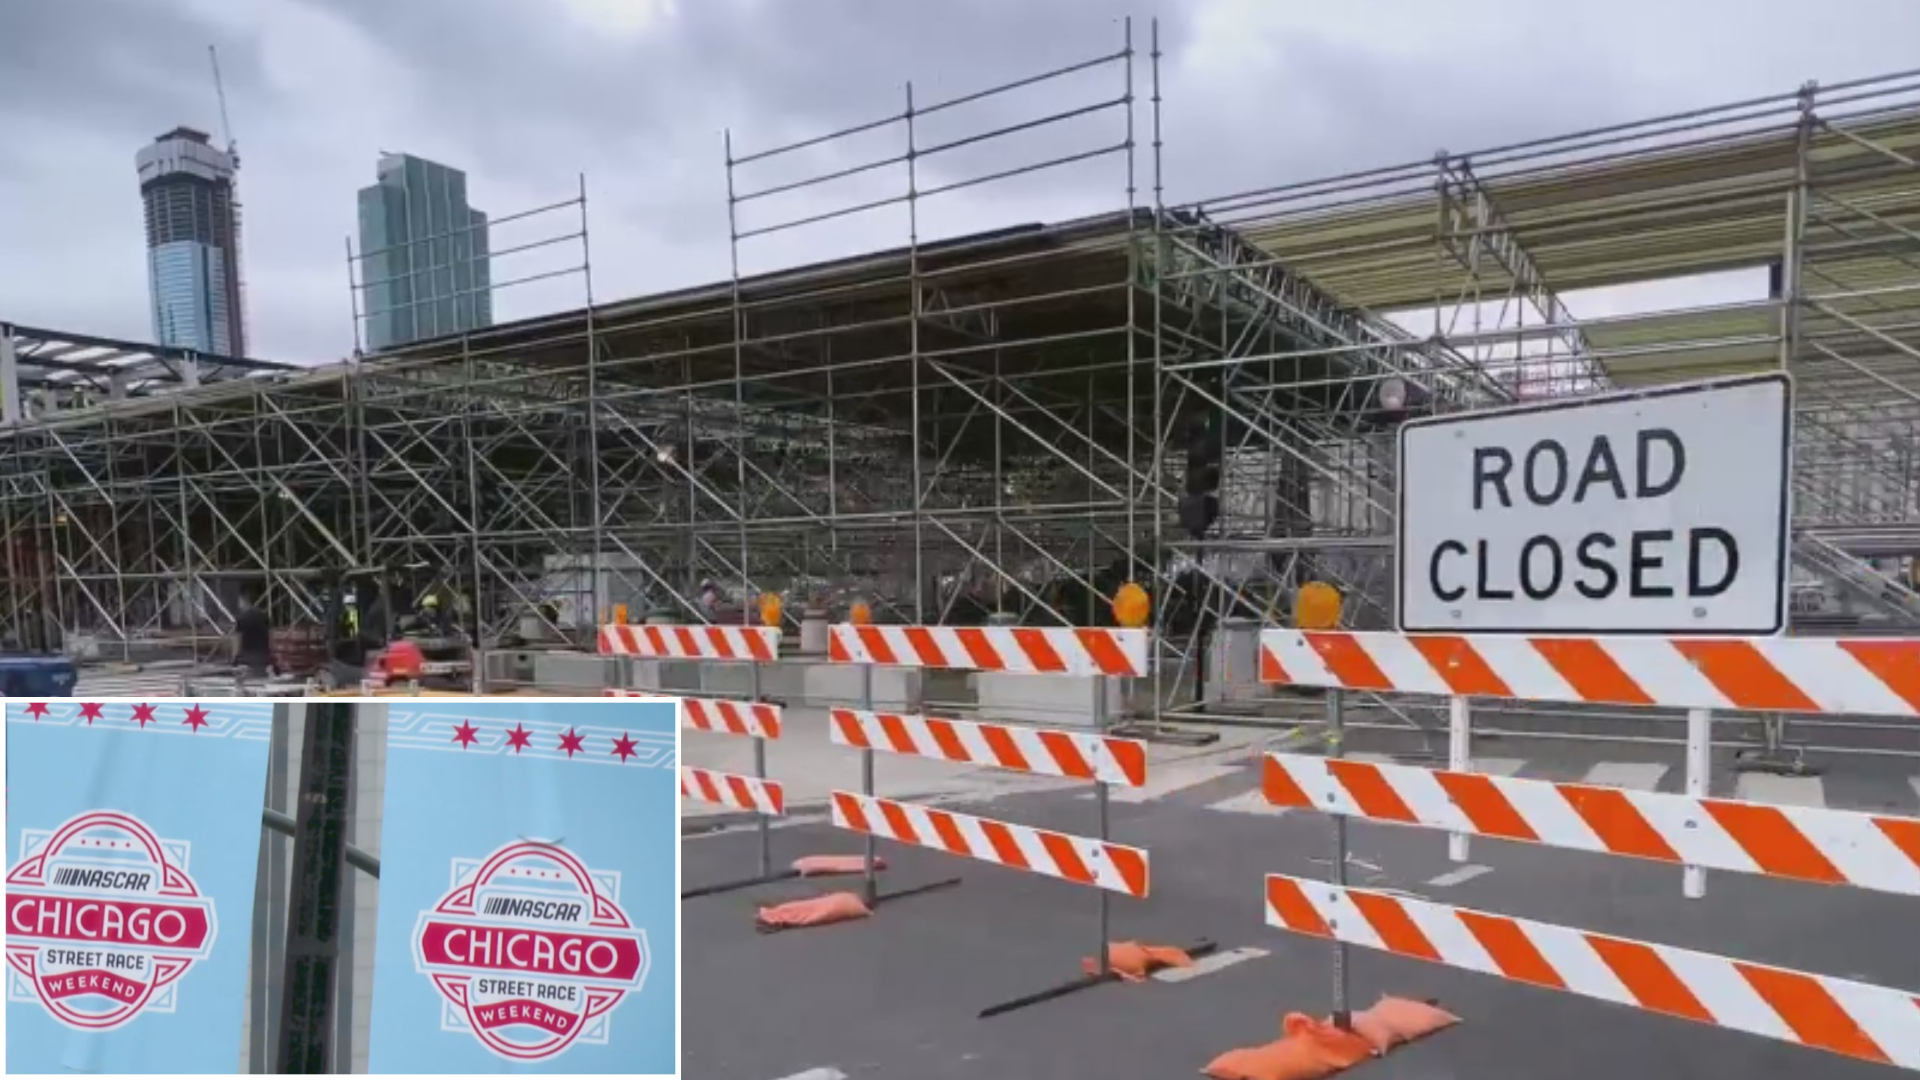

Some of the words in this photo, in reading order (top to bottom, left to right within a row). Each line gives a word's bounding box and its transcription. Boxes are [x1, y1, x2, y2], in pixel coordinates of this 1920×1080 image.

[1473, 429, 1686, 510] ROAD
[1429, 527, 1739, 602] CLOSED
[74, 869, 150, 891] NASCAR
[11, 899, 187, 943] CHICAGO
[505, 900, 582, 921] NASCAR
[46, 949, 104, 968] STREET
[106, 953, 144, 970] RACE
[443, 929, 619, 974] CHICAGO
[49, 975, 136, 999] WEEKEND
[479, 979, 534, 997] STREET
[537, 983, 577, 1001] RACE
[480, 1005, 568, 1030] WEEKEND
